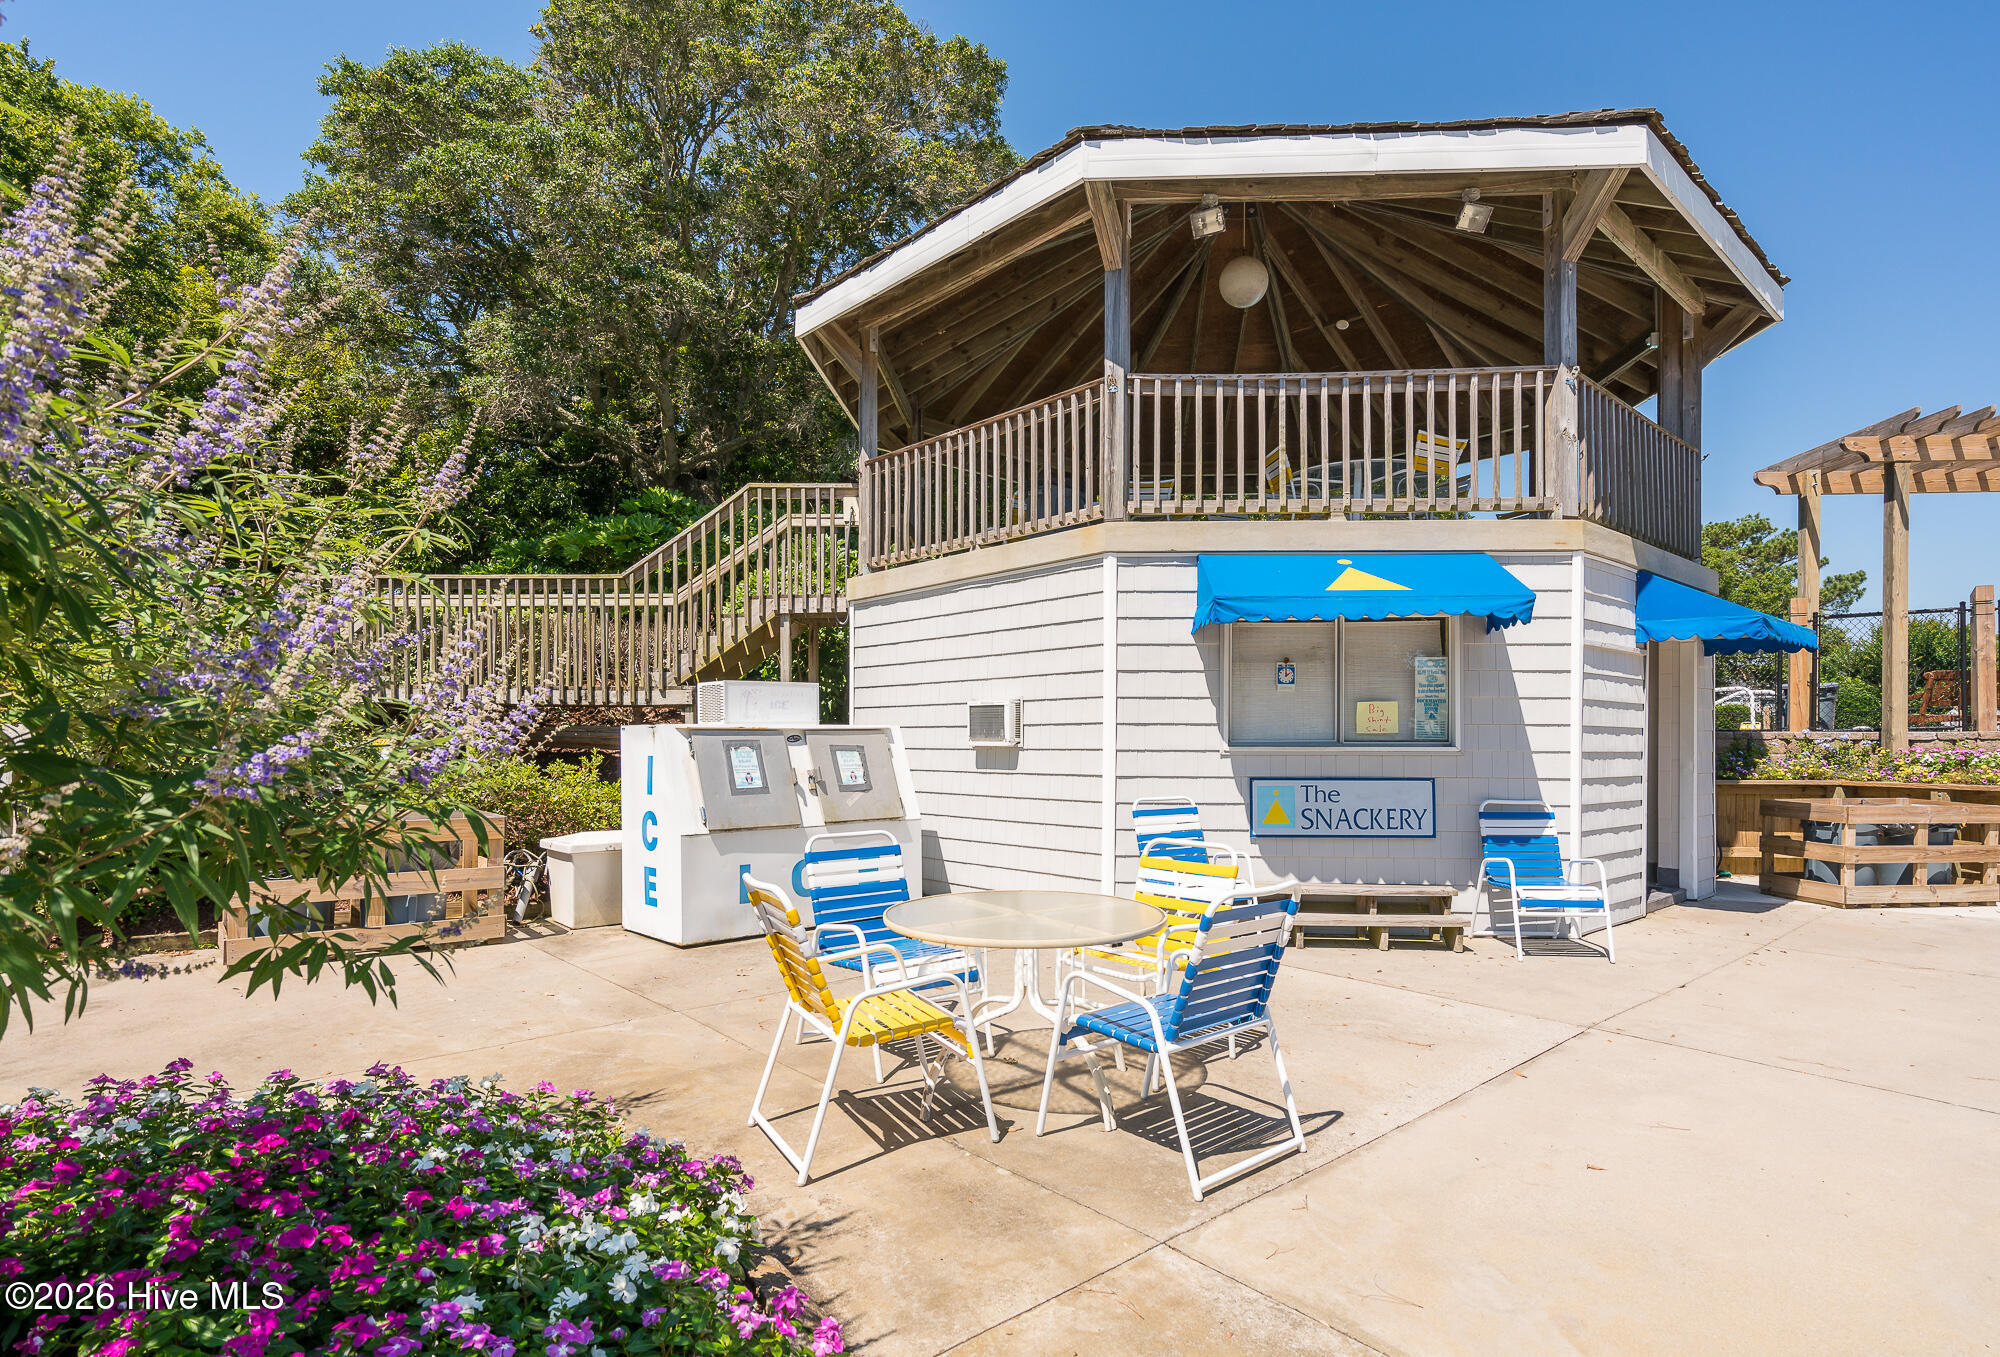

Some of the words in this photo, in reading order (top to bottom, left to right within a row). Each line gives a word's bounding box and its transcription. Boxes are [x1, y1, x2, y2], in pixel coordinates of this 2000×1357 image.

[1368, 703, 1385, 717] Big
[1300, 784, 1341, 803] The
[1300, 808, 1428, 831] SNACKERY
[641, 755, 658, 908] ICE
